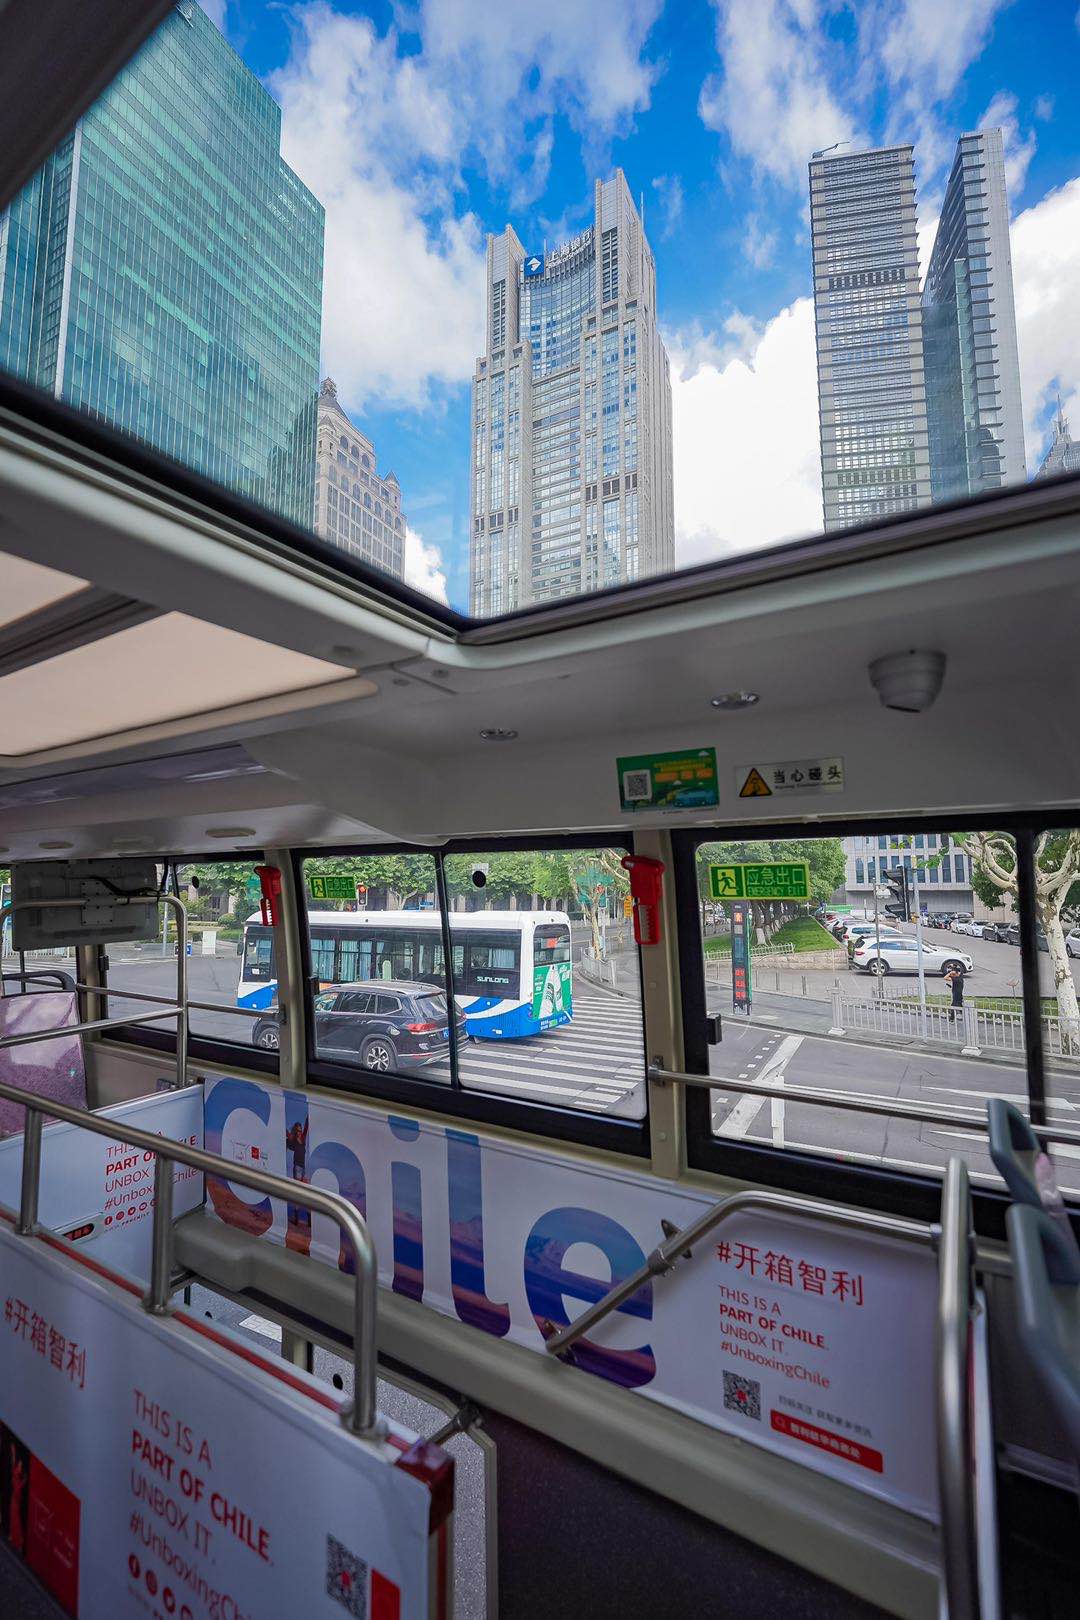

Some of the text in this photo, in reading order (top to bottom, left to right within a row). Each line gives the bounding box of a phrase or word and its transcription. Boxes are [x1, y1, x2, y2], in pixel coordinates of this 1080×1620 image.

[747, 866, 805, 886] 应急出口
[105, 1167, 150, 1193] UNBOX
[106, 1154, 140, 1176] PART
[204, 1076, 657, 1388] Chile
[716, 1241, 865, 1306] #开箱智利
[719, 1285, 782, 1316] THIS IS A
[719, 1303, 754, 1325] PART
[758, 1316, 777, 1332] OF
[4, 1297, 86, 1390] #开箱智利
[720, 1322, 767, 1349] UNBOX
[720, 1341, 831, 1389] #UnboxingChile
[134, 1388, 212, 1470] THIS IS A
[132, 1429, 175, 1481] PART
[179, 1468, 205, 1503] OF
[131, 1467, 190, 1540] UNBOX
